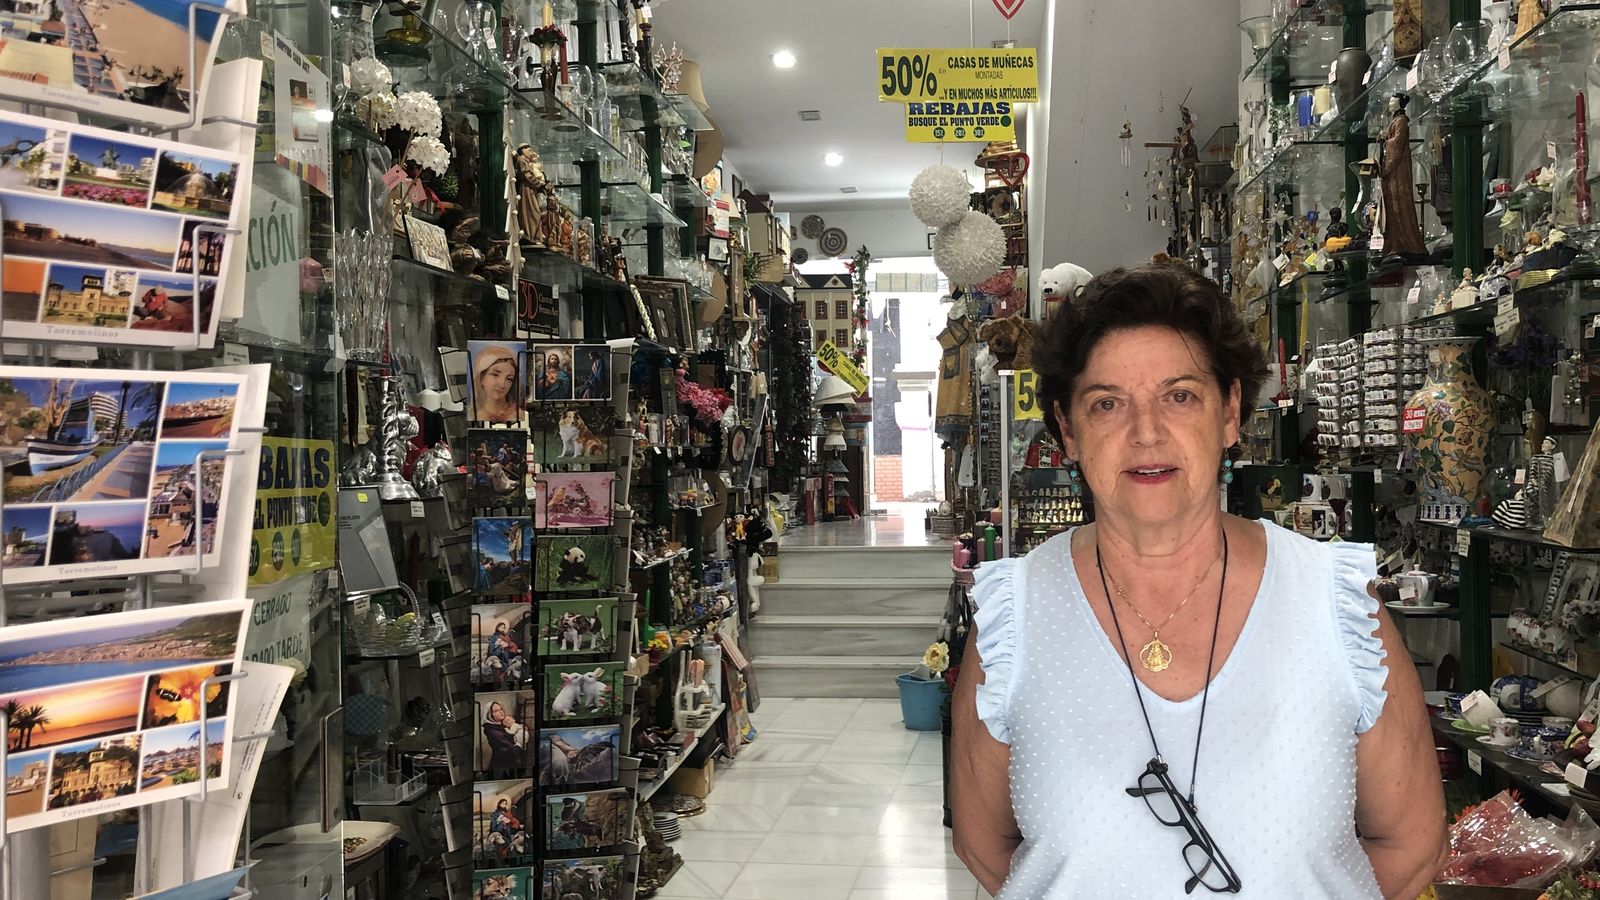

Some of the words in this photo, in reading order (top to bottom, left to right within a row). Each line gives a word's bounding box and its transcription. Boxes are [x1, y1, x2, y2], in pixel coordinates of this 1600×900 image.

[947, 56, 977, 69] CASAS
[978, 57, 990, 69] DE
[992, 53, 1034, 69] MUÑECAS
[882, 54, 938, 96] 50%
[975, 70, 1004, 80] MONTADAS
[949, 88, 957, 100] EN
[958, 88, 983, 100] MUCHOS
[985, 85, 998, 100] MÁS
[908, 102, 1011, 116] REBAJAS
[908, 117, 938, 127] BUSQUE
[939, 117, 949, 127] EL
[950, 117, 975, 127] PUNTO
[976, 116, 1000, 126] VERDE
[246, 200, 296, 272] CIÓN
[46, 325, 119, 338] Torremolinos
[819, 343, 840, 369] 50%
[267, 496, 293, 529] PUNTO
[253, 591, 292, 627] CERRADO
[276, 632, 303, 663] TARDE
